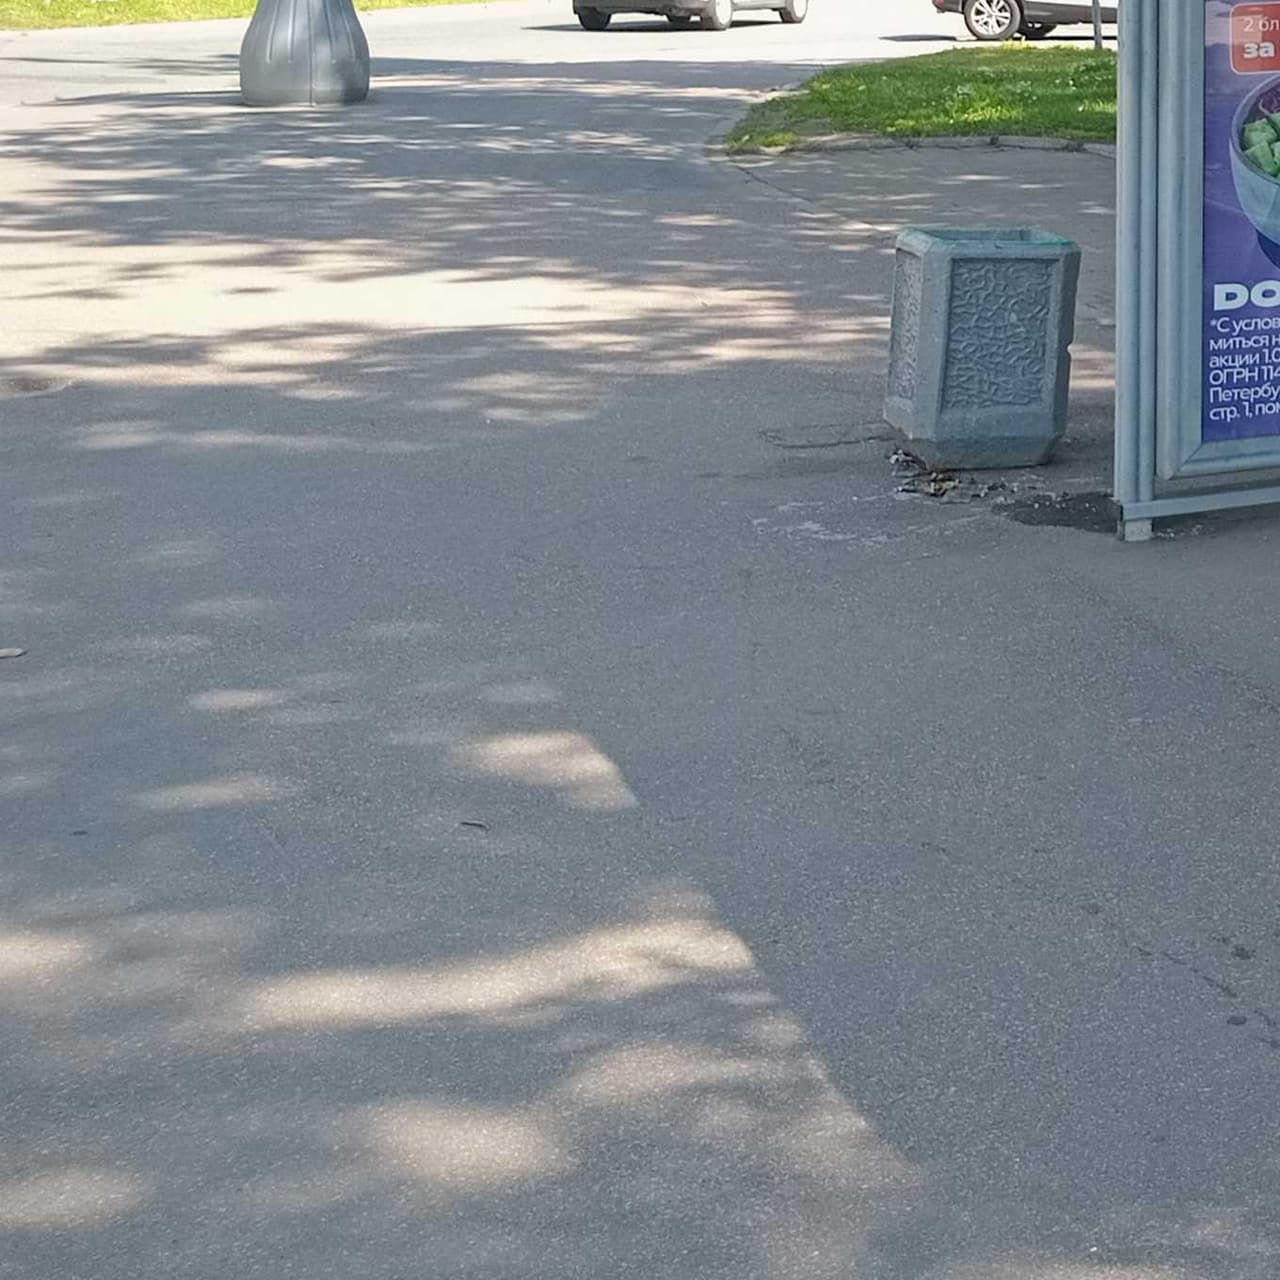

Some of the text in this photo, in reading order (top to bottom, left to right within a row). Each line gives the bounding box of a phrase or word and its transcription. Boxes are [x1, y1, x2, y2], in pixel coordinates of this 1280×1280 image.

[1243, 17, 1254, 32] 2
[1243, 41, 1275, 59] за
[1209, 334, 1269, 351] миться
[1209, 352, 1260, 368] акции
[1209, 367, 1258, 385] ОГРН
[1209, 406, 1241, 422] стр.
